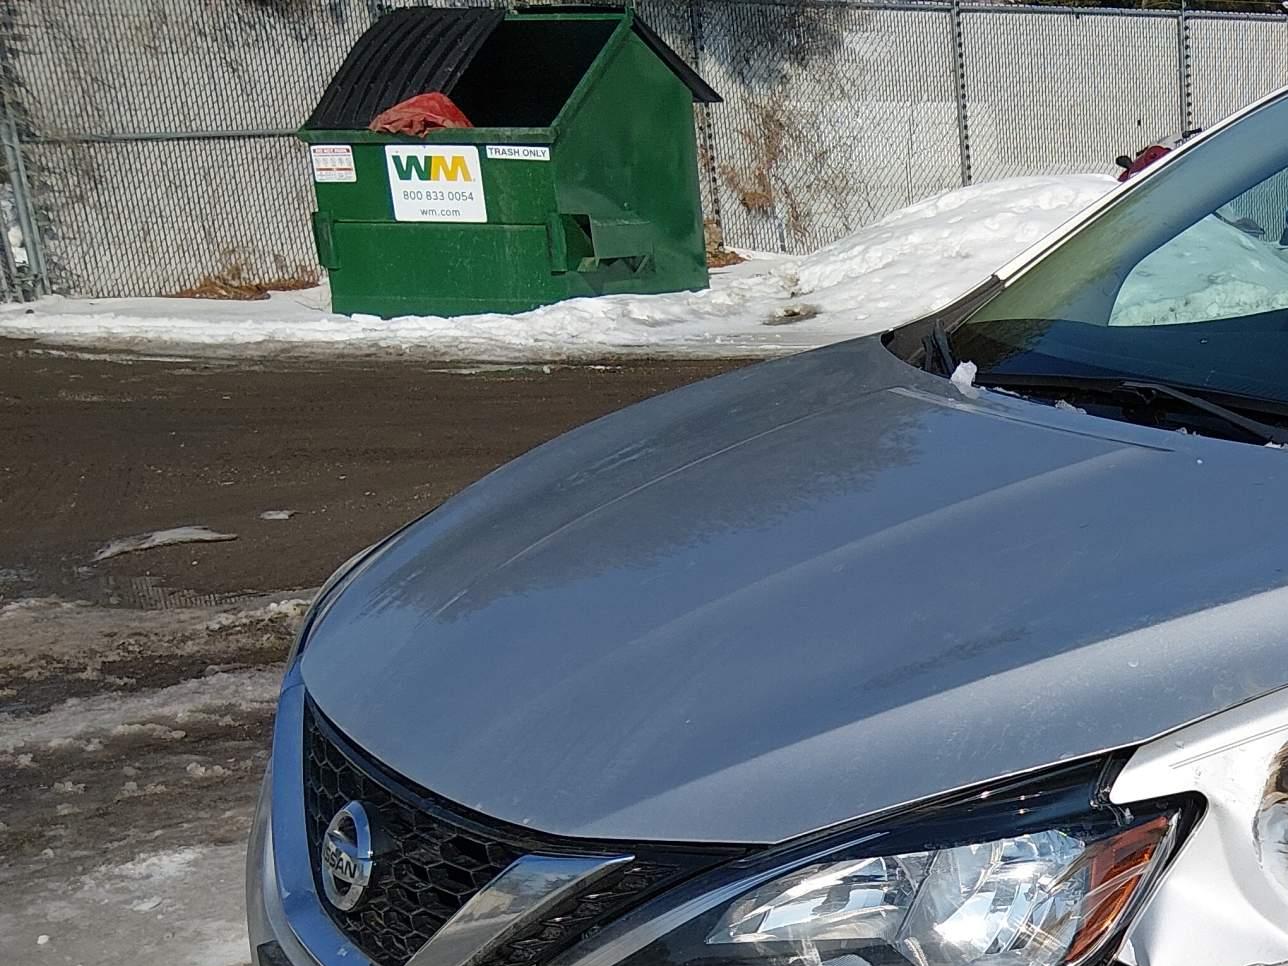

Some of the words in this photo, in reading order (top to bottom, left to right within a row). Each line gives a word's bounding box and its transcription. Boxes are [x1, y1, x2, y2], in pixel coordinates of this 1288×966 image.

[488, 147, 520, 156] TRASH
[522, 149, 547, 157] ONLY
[391, 154, 473, 182] WM
[403, 190, 423, 200] 800
[426, 191, 445, 201] 833
[448, 192, 474, 201] 0054
[420, 207, 461, 217] wm.com
